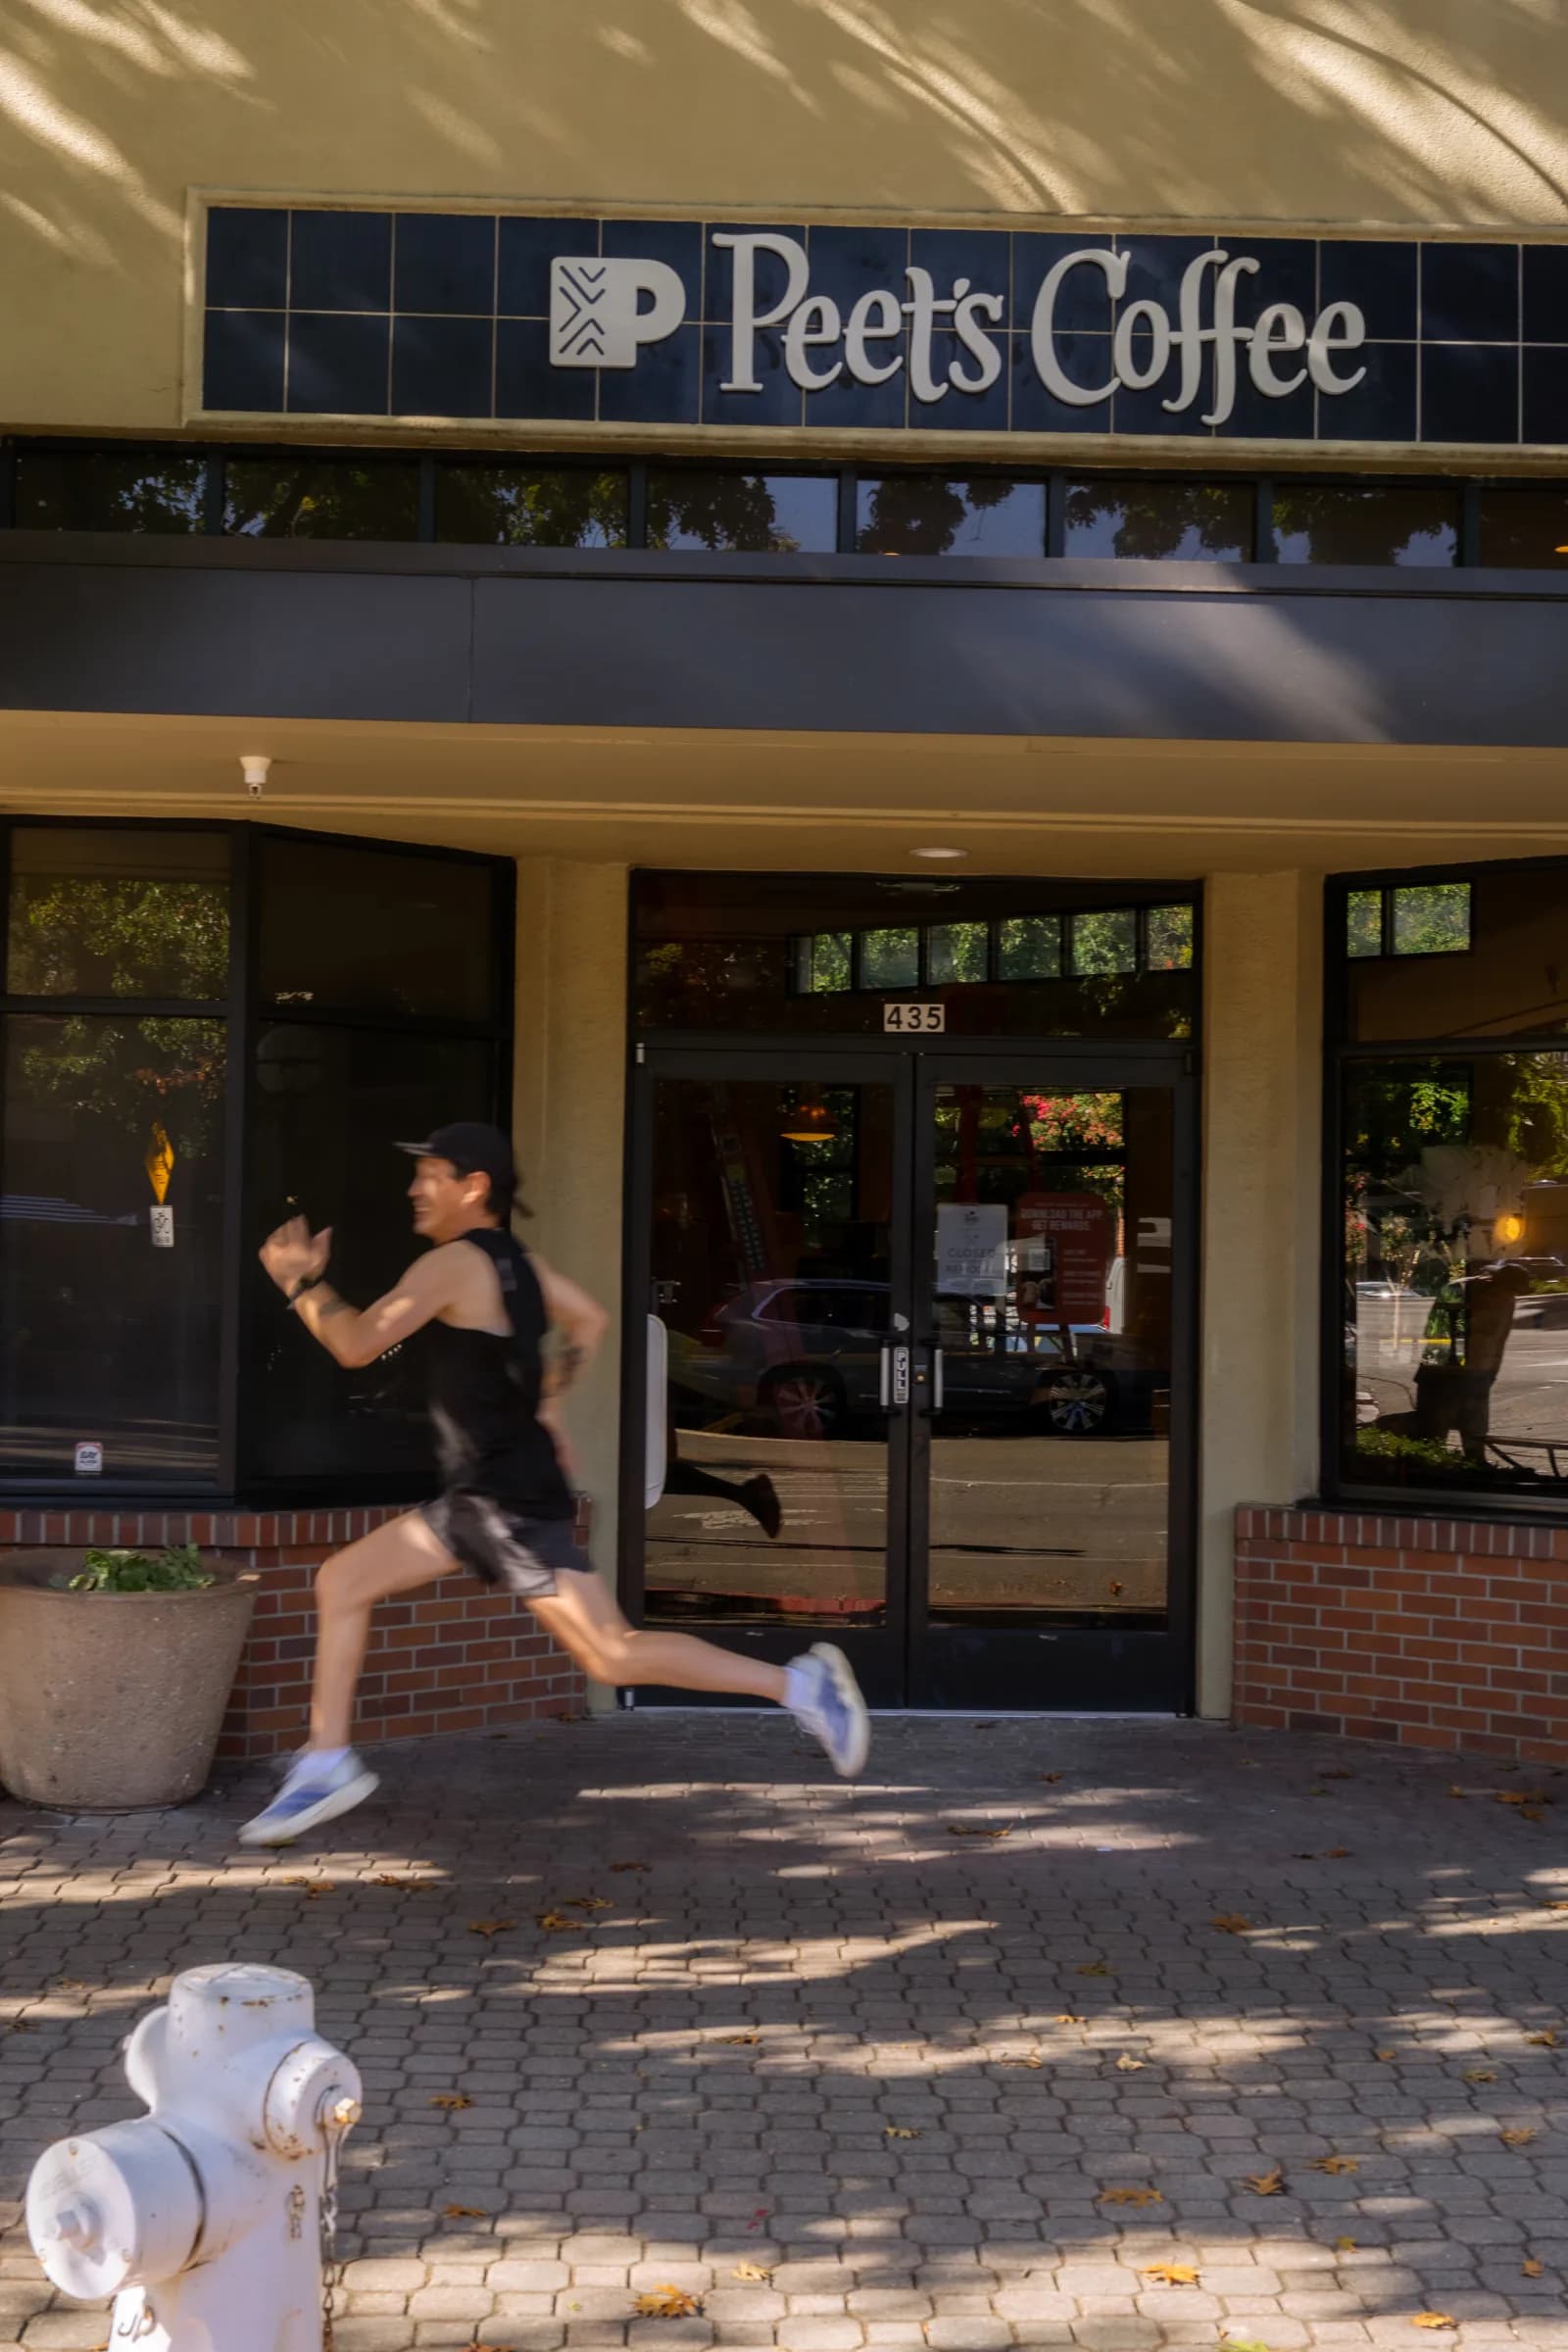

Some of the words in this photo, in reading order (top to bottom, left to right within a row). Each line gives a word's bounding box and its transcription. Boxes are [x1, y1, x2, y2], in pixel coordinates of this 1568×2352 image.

[711, 232, 1004, 403] Peet's
[1032, 249, 1367, 426] Coffee
[886, 1005, 942, 1030] 435
[897, 1351, 906, 1390] PULL
